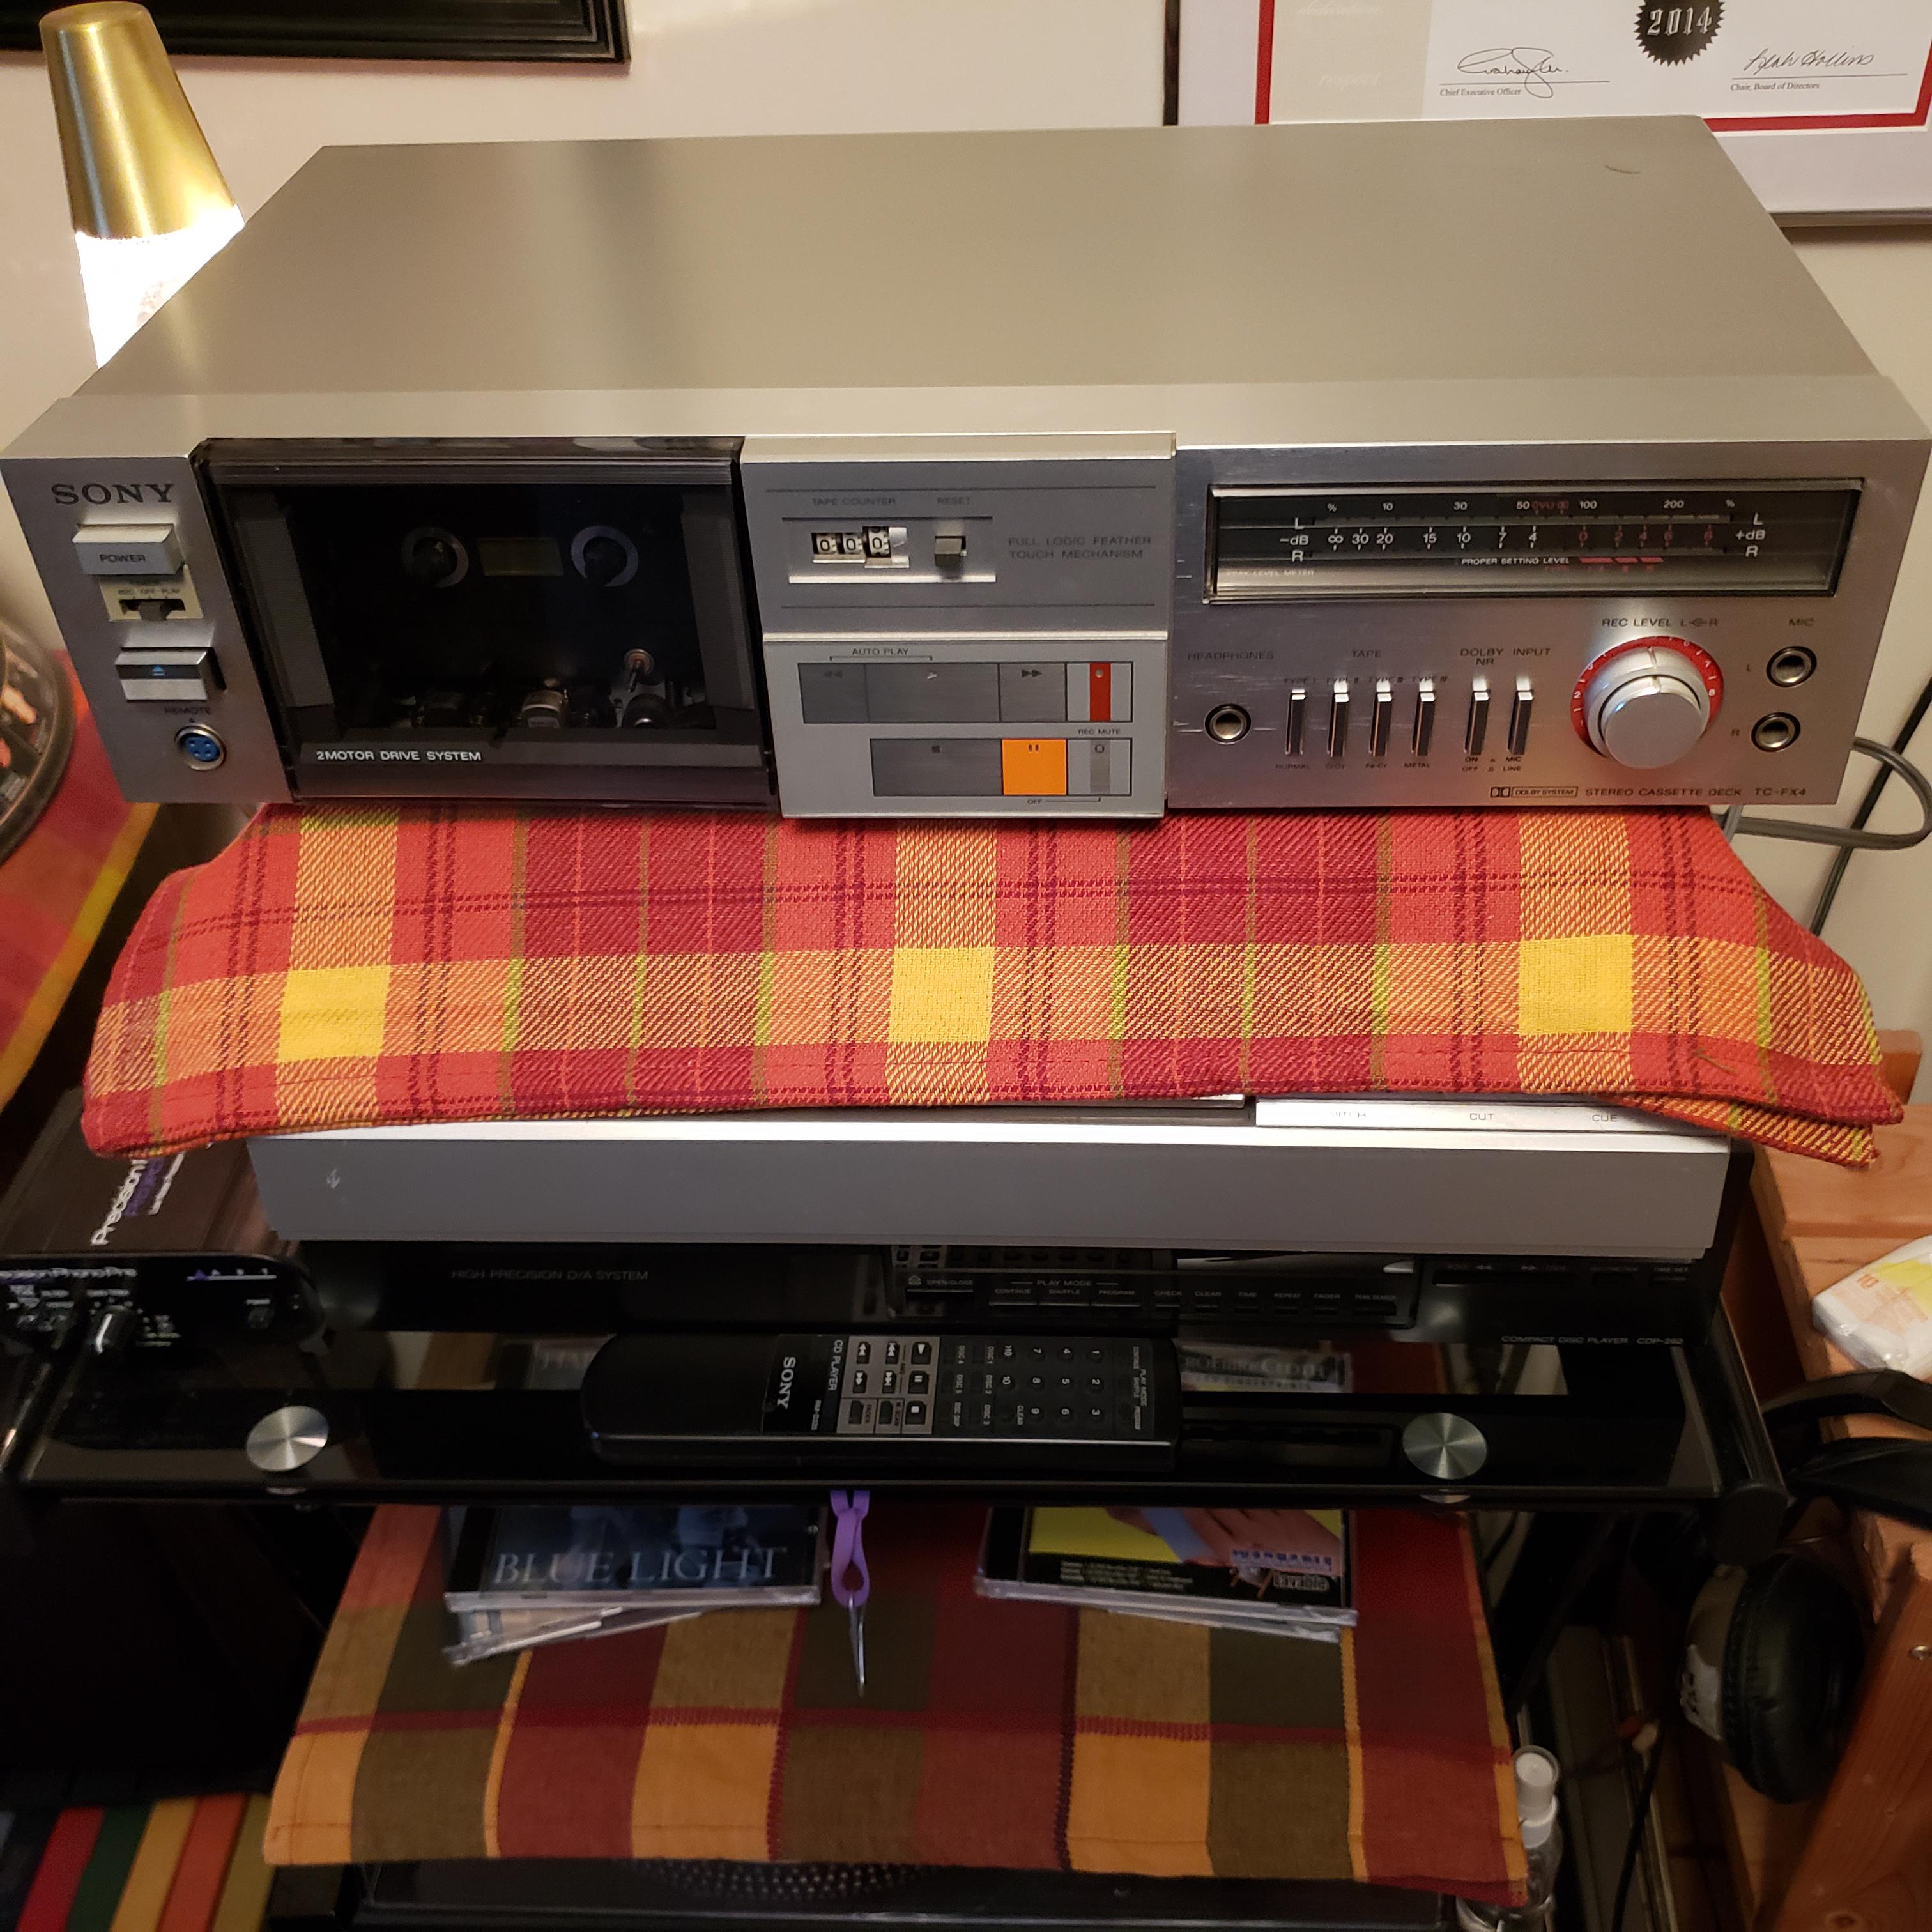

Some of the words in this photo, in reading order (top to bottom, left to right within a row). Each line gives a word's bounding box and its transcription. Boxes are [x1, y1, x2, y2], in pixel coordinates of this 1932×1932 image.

[1647, 6, 1712, 36] 2014
[1439, 88, 1459, 96] Chief
[1496, 88, 1522, 96] Officer
[1730, 83, 1752, 92] Chair,
[1754, 82, 1775, 91] Board
[1777, 82, 1786, 90] of
[1787, 82, 1820, 90] Directors
[50, 483, 174, 505] SONY
[842, 498, 896, 506] COUNTER
[1383, 503, 1393, 511] 10
[1453, 502, 1468, 510] 30
[1517, 501, 1530, 509] 50
[1579, 500, 1597, 509] 100
[1664, 500, 1684, 509] 200
[1294, 518, 1305, 530] L
[1753, 512, 1764, 526] L
[1352, 533, 1369, 544] 30
[1376, 533, 1393, 544] 20
[1423, 533, 1437, 544] 15
[1457, 533, 1471, 543] 10
[1735, 529, 1766, 540] +dB
[1008, 537, 1036, 546] FULL
[1046, 536, 1085, 546] LOGIC
[1093, 536, 1151, 545] FEATHER
[1011, 550, 1054, 559] TOUCH
[1062, 549, 1143, 559] MECHANISM
[1292, 550, 1305, 562] R
[1745, 545, 1759, 557] R
[100, 553, 146, 563] POWER
[1461, 557, 1498, 566] PROPER
[1501, 556, 1539, 565] SETTING
[1602, 618, 1628, 627] REC
[1633, 618, 1671, 627] LEVEL
[1789, 618, 1814, 627] MIC
[852, 647, 880, 656] AUTO
[884, 647, 909, 656] PLAY
[1187, 651, 1275, 661] HEADPHONES
[1352, 650, 1382, 659] TAPE
[1460, 647, 1505, 657] DOLBY
[1512, 647, 1551, 657] INPUT
[316, 750, 375, 760] 2MOTOR
[380, 751, 420, 760] DRIVE
[426, 751, 482, 761] SYSTEM
[1585, 788, 1634, 797] STEREO
[1638, 788, 1704, 797] CASSETTE
[1708, 788, 1742, 797] DECK
[1754, 788, 1807, 797] TC-FX4
[1469, 1112, 1494, 1121] CUT
[1591, 1114, 1618, 1123] CUE
[490, 1269, 562, 1278] PRECISION
[596, 1269, 648, 1280] SYSTEM
[833, 1340, 843, 1354] CD
[827, 1355, 842, 1391] PLAYER
[777, 1356, 796, 1409] SONY
[1002, 1376, 1011, 1385] 10
[493, 1551, 614, 1584] BLUE
[630, 1547, 788, 1581] LIGHT
